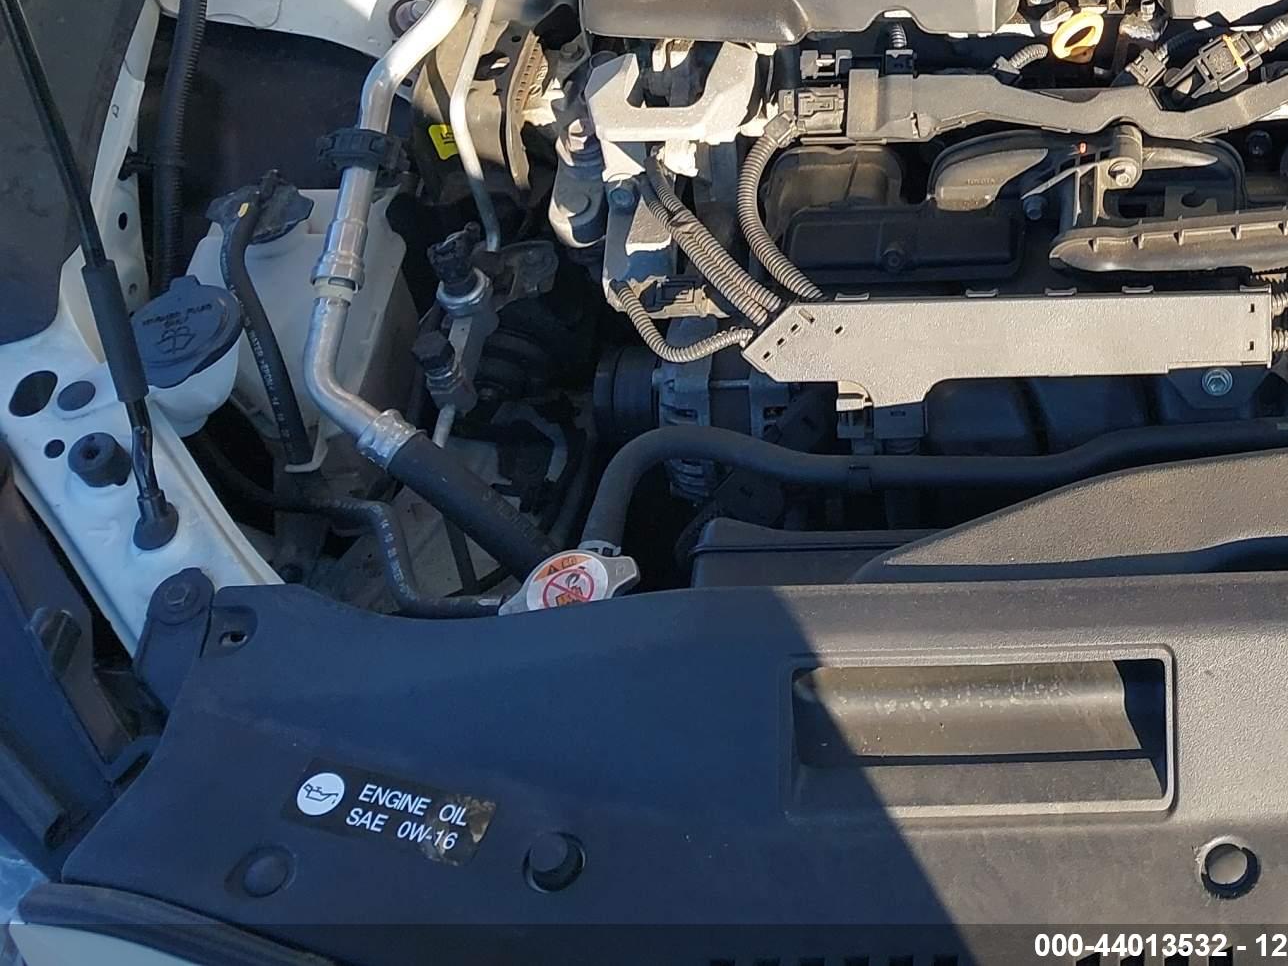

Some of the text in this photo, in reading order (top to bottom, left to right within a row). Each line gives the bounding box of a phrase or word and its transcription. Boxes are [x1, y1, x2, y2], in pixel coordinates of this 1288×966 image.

[358, 783, 468, 827] ENGINE OIL
[345, 807, 459, 851] SAE 0W-16
